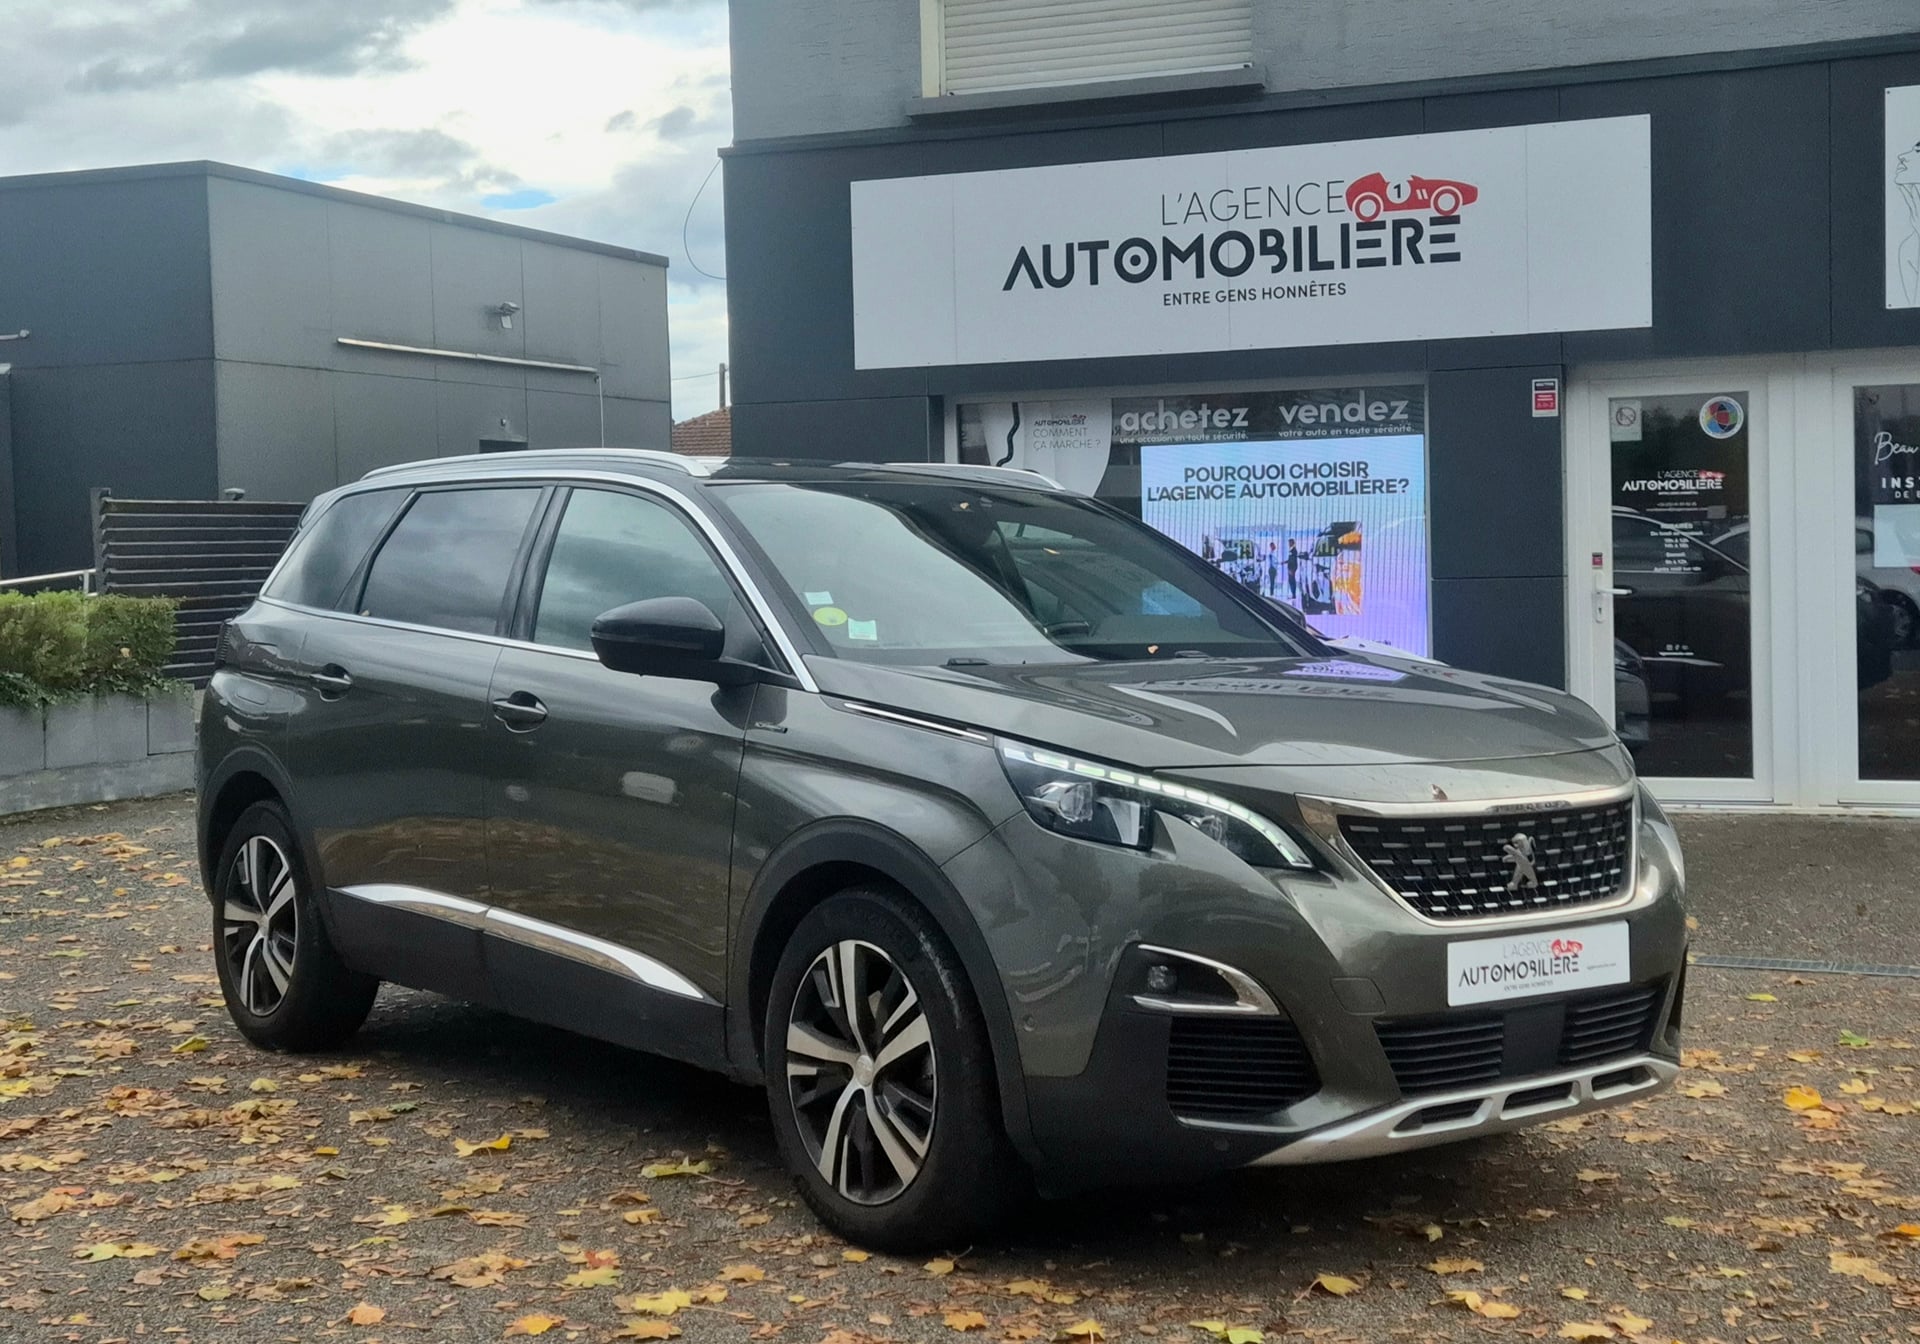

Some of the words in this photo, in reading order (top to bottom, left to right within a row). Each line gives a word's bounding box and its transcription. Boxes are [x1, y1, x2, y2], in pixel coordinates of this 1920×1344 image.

[1161, 180, 1346, 226] L'AGENCE
[1162, 290, 1211, 307] ENTRE
[1214, 287, 1257, 304] GENS
[1261, 280, 1347, 301] HONNÊTES
[1278, 389, 1409, 425] vendez
[1120, 399, 1249, 431] achetez
[1033, 427, 1088, 438] COMMENT
[1138, 434, 1174, 443] occasion
[1187, 432, 1210, 441] toute
[1278, 429, 1302, 438] votre
[1306, 428, 1328, 437] auto
[1330, 428, 1342, 436] en
[1345, 426, 1370, 435] toute
[1033, 440, 1049, 451] ÇA
[1051, 439, 1094, 450] MARCHE
[1184, 464, 1285, 483] POURQUOI
[1290, 461, 1369, 478] CHOISIR
[1657, 470, 1700, 479] L'AGENCE
[1881, 476, 1920, 489] INS
[1147, 484, 1236, 501] L'AGENCE
[1894, 490, 1910, 499] DE
